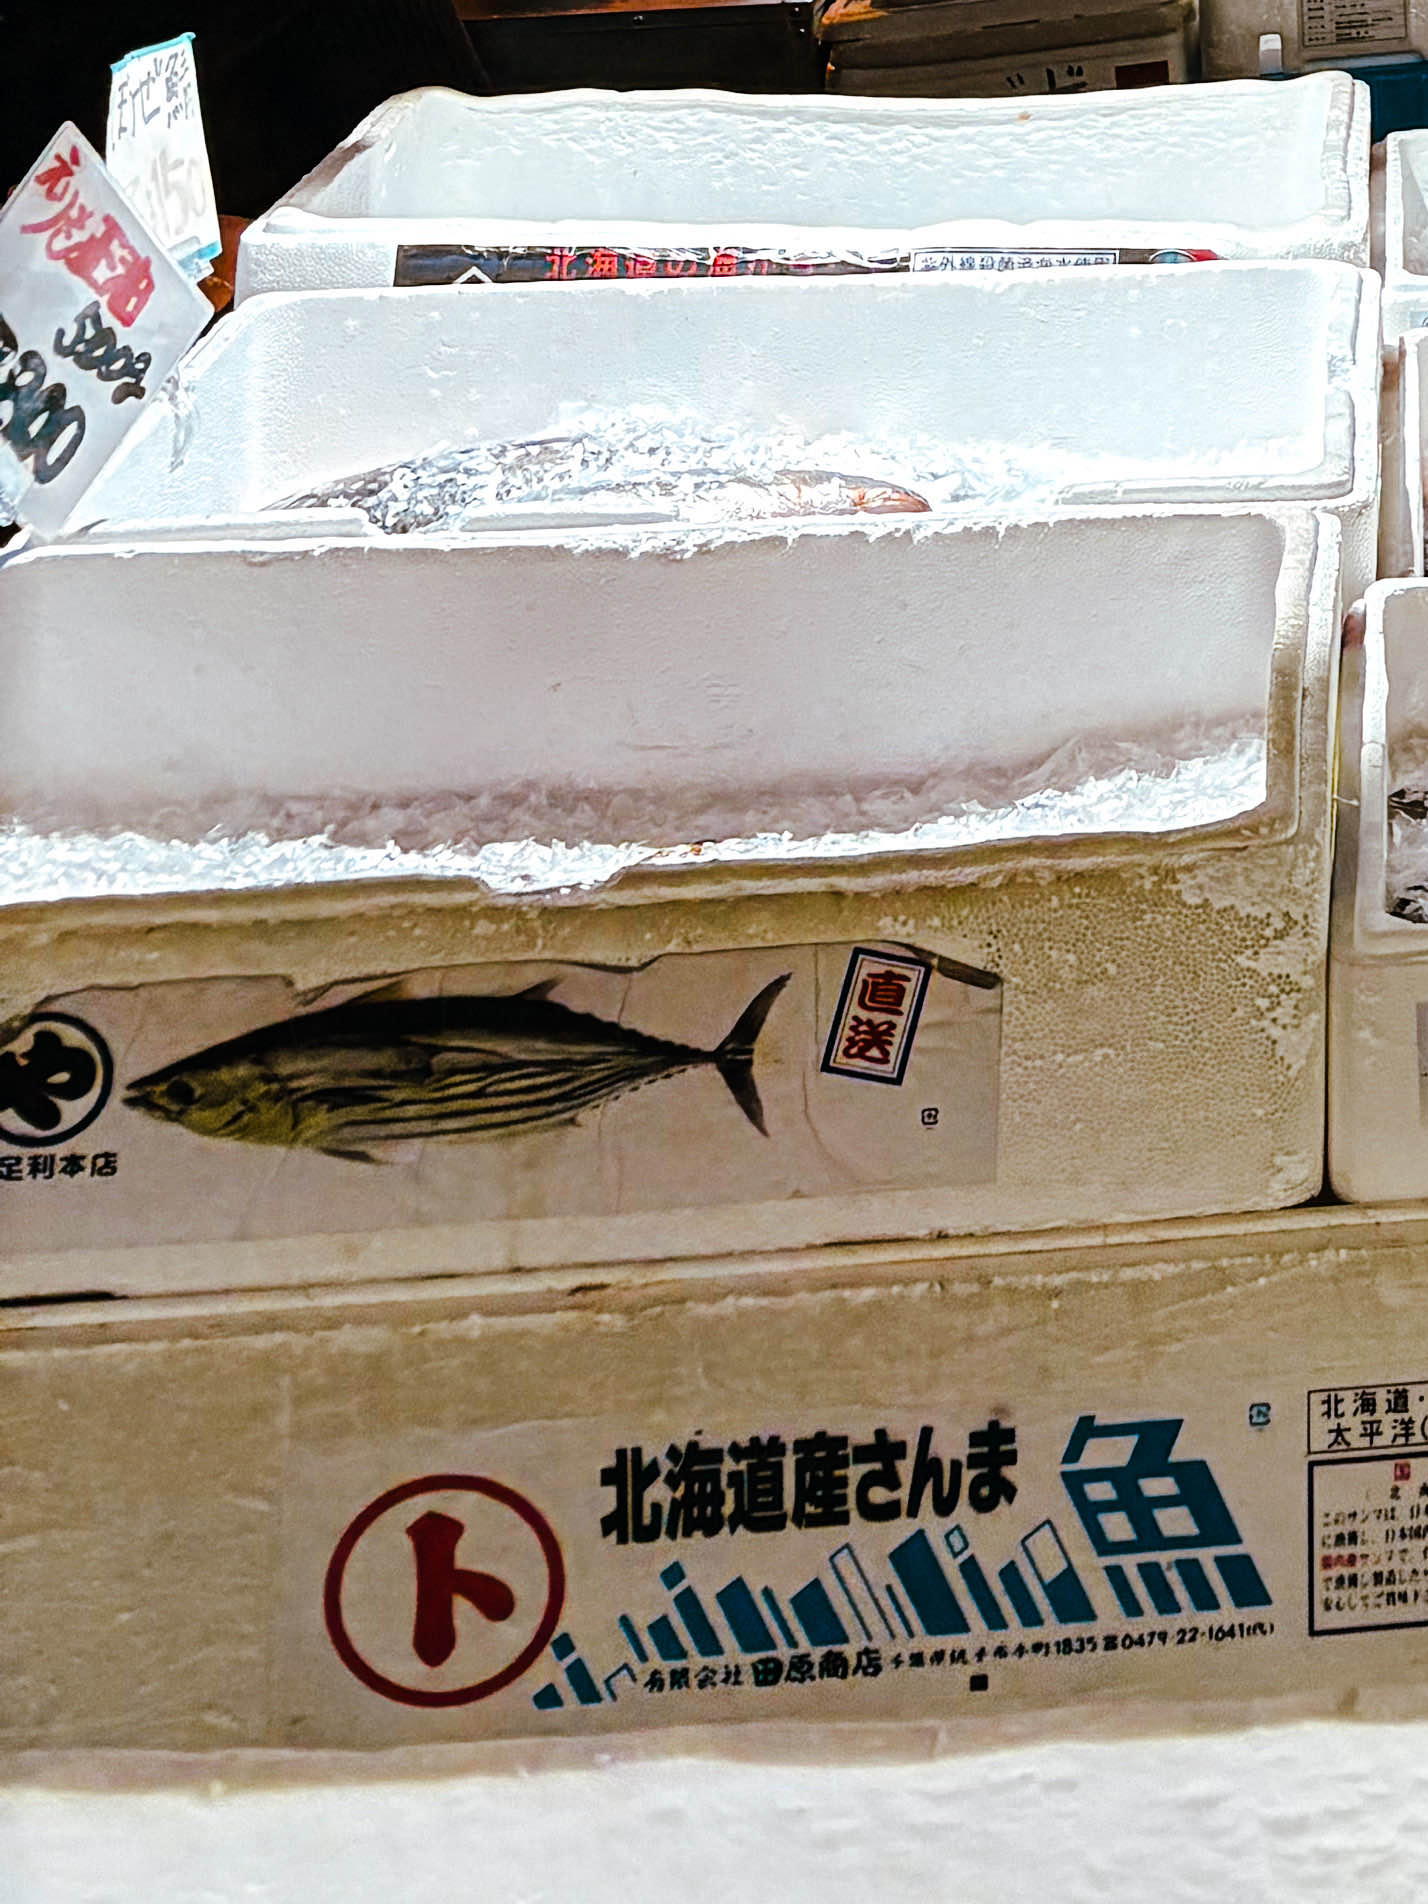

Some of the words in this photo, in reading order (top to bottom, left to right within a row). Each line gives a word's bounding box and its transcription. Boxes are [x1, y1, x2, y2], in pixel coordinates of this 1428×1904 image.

[841, 969, 912, 1065] 直送
[601, 1420, 1018, 1546] 北海道産さんま
[752, 1646, 884, 1689] 田原商店
